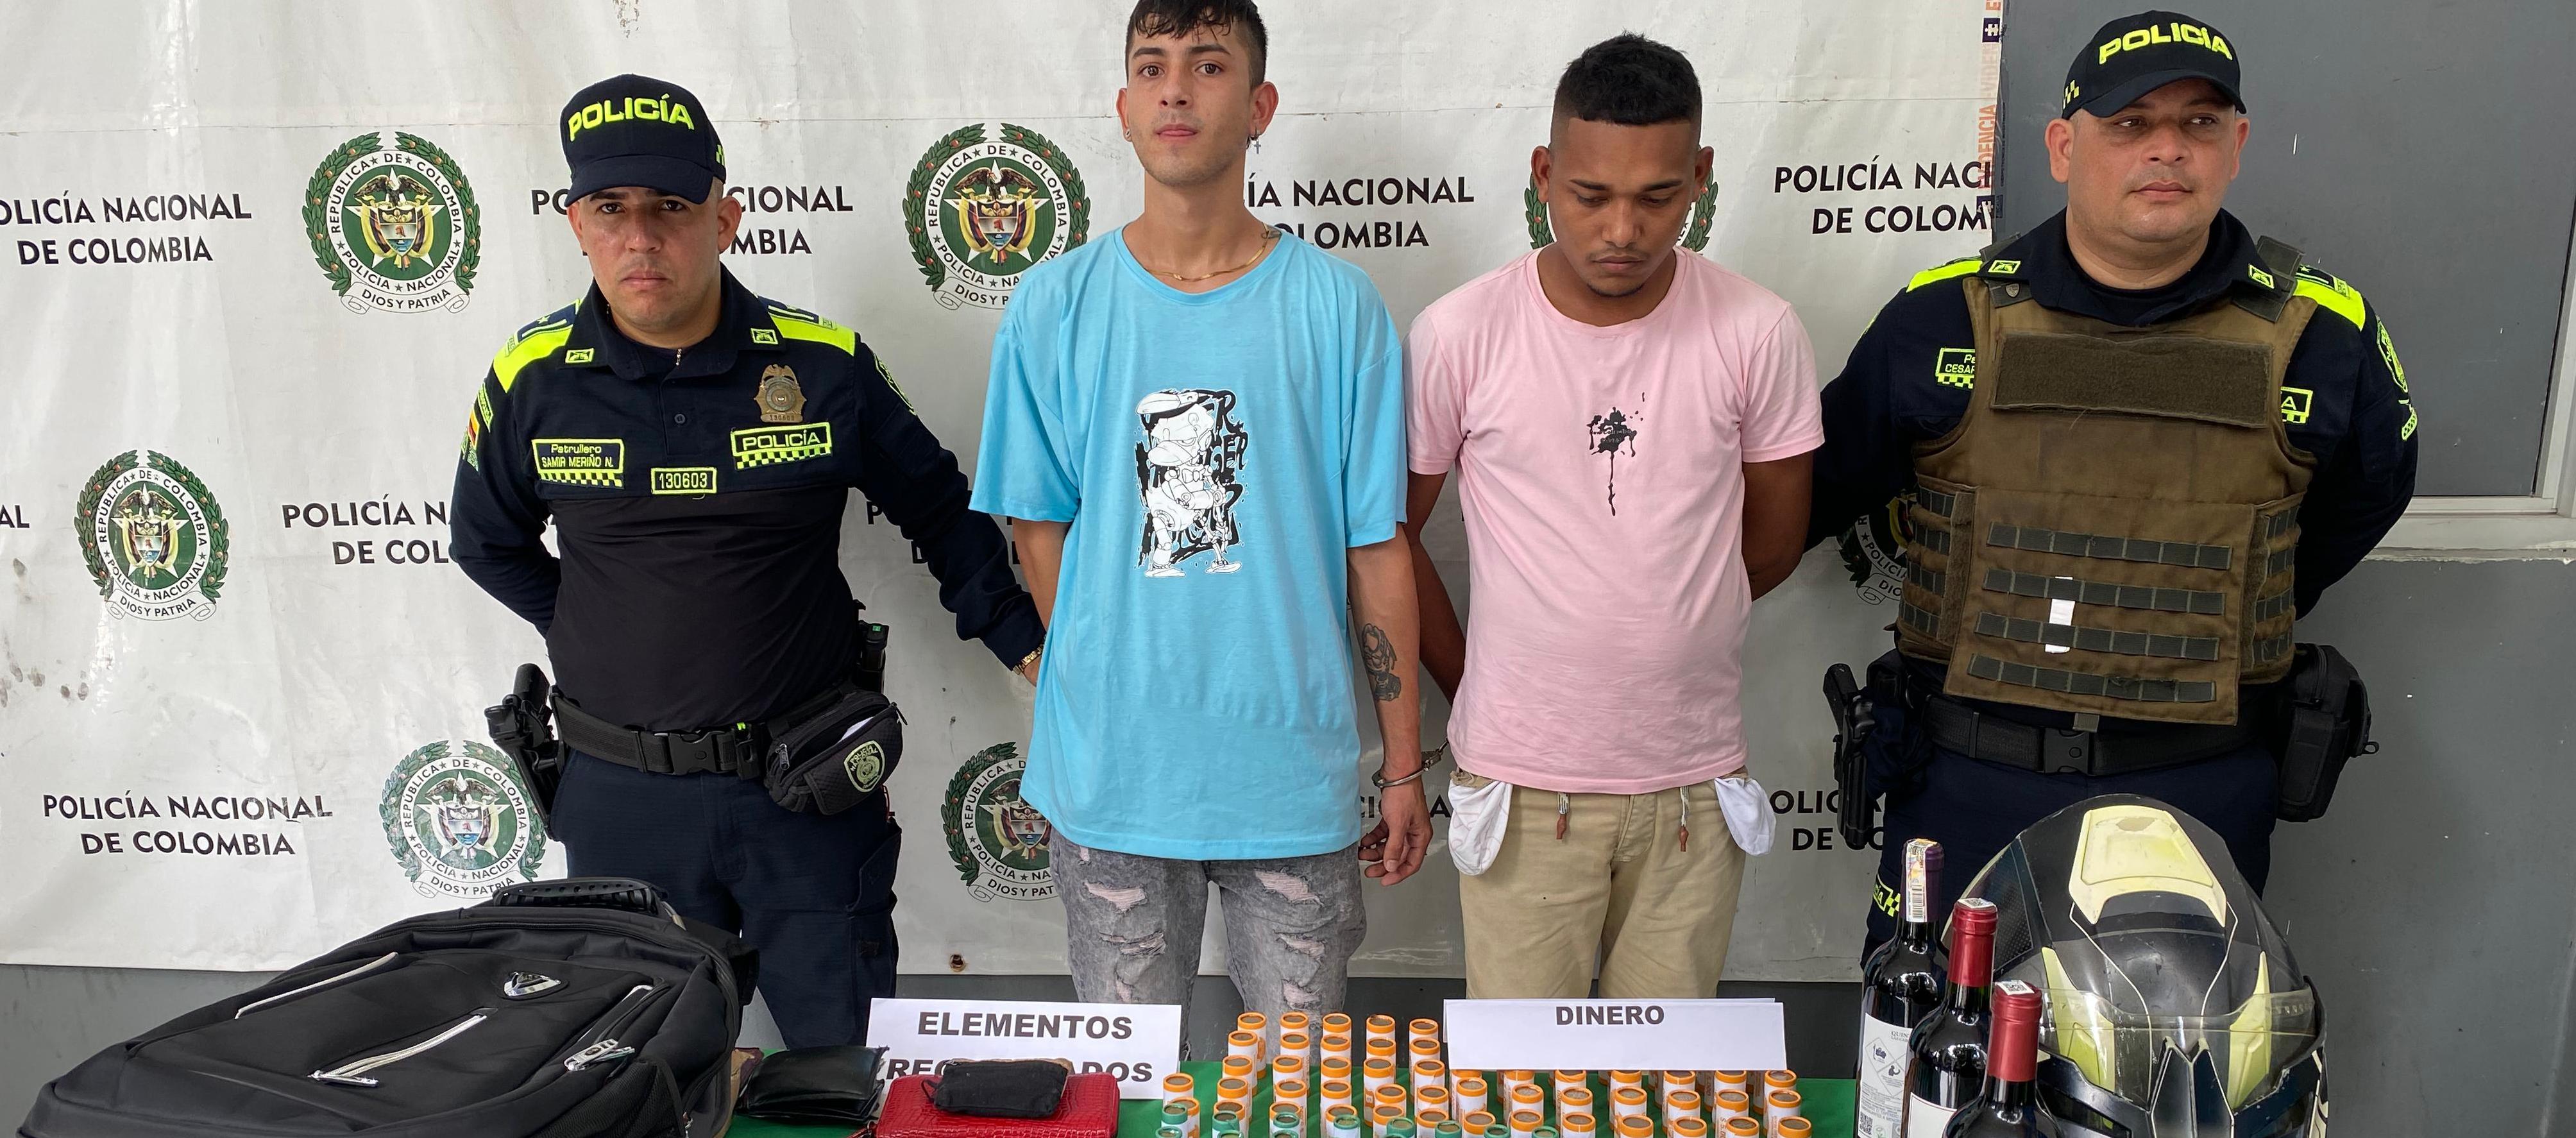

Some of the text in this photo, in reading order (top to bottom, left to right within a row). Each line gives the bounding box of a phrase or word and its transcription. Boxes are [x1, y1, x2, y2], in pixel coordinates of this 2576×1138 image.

[2099, 22, 2232, 65] POLICÍA
[568, 93, 694, 140] POLICÍA
[928, 145, 1067, 228] REPÚBLICA DE COLOMBIA
[1774, 155, 1991, 192] POLICÍA NACI
[329, 153, 461, 233] REPÚBLICA DE COLOMBIA
[726, 185, 854, 213] CIONAL
[1293, 176, 1475, 207] NACIONAL
[0, 191, 251, 226] OLICÍA NACIONAL
[1812, 204, 1987, 234] DE COLOM
[17, 235, 214, 265] DE COLOMBIA
[731, 228, 812, 254] MBIA
[1276, 220, 1429, 250] LOMBIA
[342, 249, 459, 291] POLICÍA NACIONAL
[937, 244, 985, 285] POLICÍA
[362, 289, 451, 309] DIOS Y PATRIA
[954, 284, 987, 303] DIOS
[988, 295, 998, 305] Y
[551, 444, 602, 454] Patrullero
[742, 429, 820, 450] POLICÍA
[541, 454, 614, 468] SAMIR MERIÑO N.
[659, 473, 708, 489] 130603
[98, 470, 208, 547] REPÚBLICA DE COLOMBIA
[282, 493, 416, 528] POLICÍA
[332, 540, 375, 565] DE
[108, 559, 207, 600] POLICÍA NACIONAL
[1878, 579, 1901, 597] DIO
[120, 595, 197, 616] DIOS Y PATRIA
[43, 790, 333, 820] POLICÍA NACIONAL
[403, 759, 527, 829] REPÚBLICA DE COLOMBIA
[965, 765, 1005, 829] REPÚBLICA
[81, 831, 295, 856] DE COLOMBIA
[1792, 828, 1833, 851] DE
[414, 842, 525, 879] POLICÍA NACIONAL
[972, 844, 1015, 879] POLICÍA
[430, 876, 461, 894] DIOS
[461, 886, 469, 895] Y
[987, 878, 1055, 897] DIOS Y PAT
[917, 1011, 1132, 1040] ELEMENTOS
[1555, 1005, 1665, 1026] DINERO
